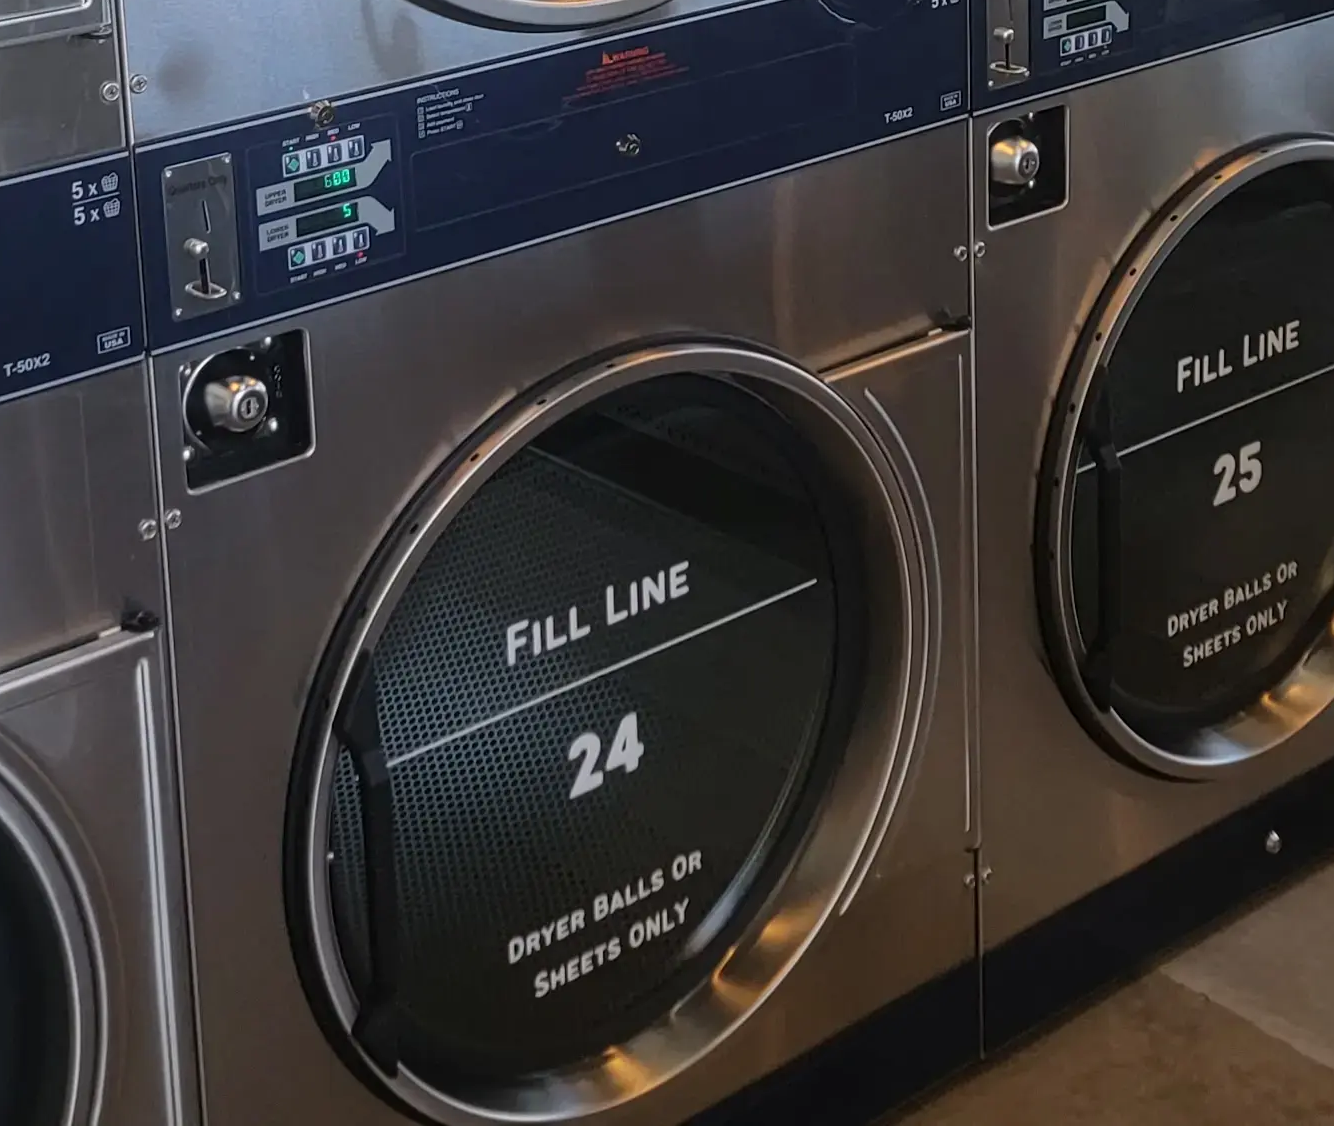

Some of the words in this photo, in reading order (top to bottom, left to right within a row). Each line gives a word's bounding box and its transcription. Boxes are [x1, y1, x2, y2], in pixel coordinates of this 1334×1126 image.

[71, 180, 84, 200] 5
[88, 182, 98, 197] x
[73, 206, 86, 226] 5
[90, 208, 100, 222] x
[3, 353, 51, 377] T-50X2
[1176, 348, 1233, 394] FILL
[1242, 319, 1301, 369] LINE
[1212, 440, 1263, 507] 25
[505, 606, 591, 667] FILL
[605, 560, 690, 626] LINE
[1167, 597, 1219, 638] DRYER
[1223, 571, 1272, 611] BALLS
[1276, 560, 1298, 585] OR
[1182, 624, 1241, 668] SHEETS
[1245, 599, 1289, 636] ONLY
[568, 712, 644, 800] 24
[507, 908, 586, 965] DRYER
[593, 868, 664, 923] BALLS
[671, 849, 703, 880] OR
[533, 937, 621, 999] SHEETS
[628, 897, 690, 948] ONLY
